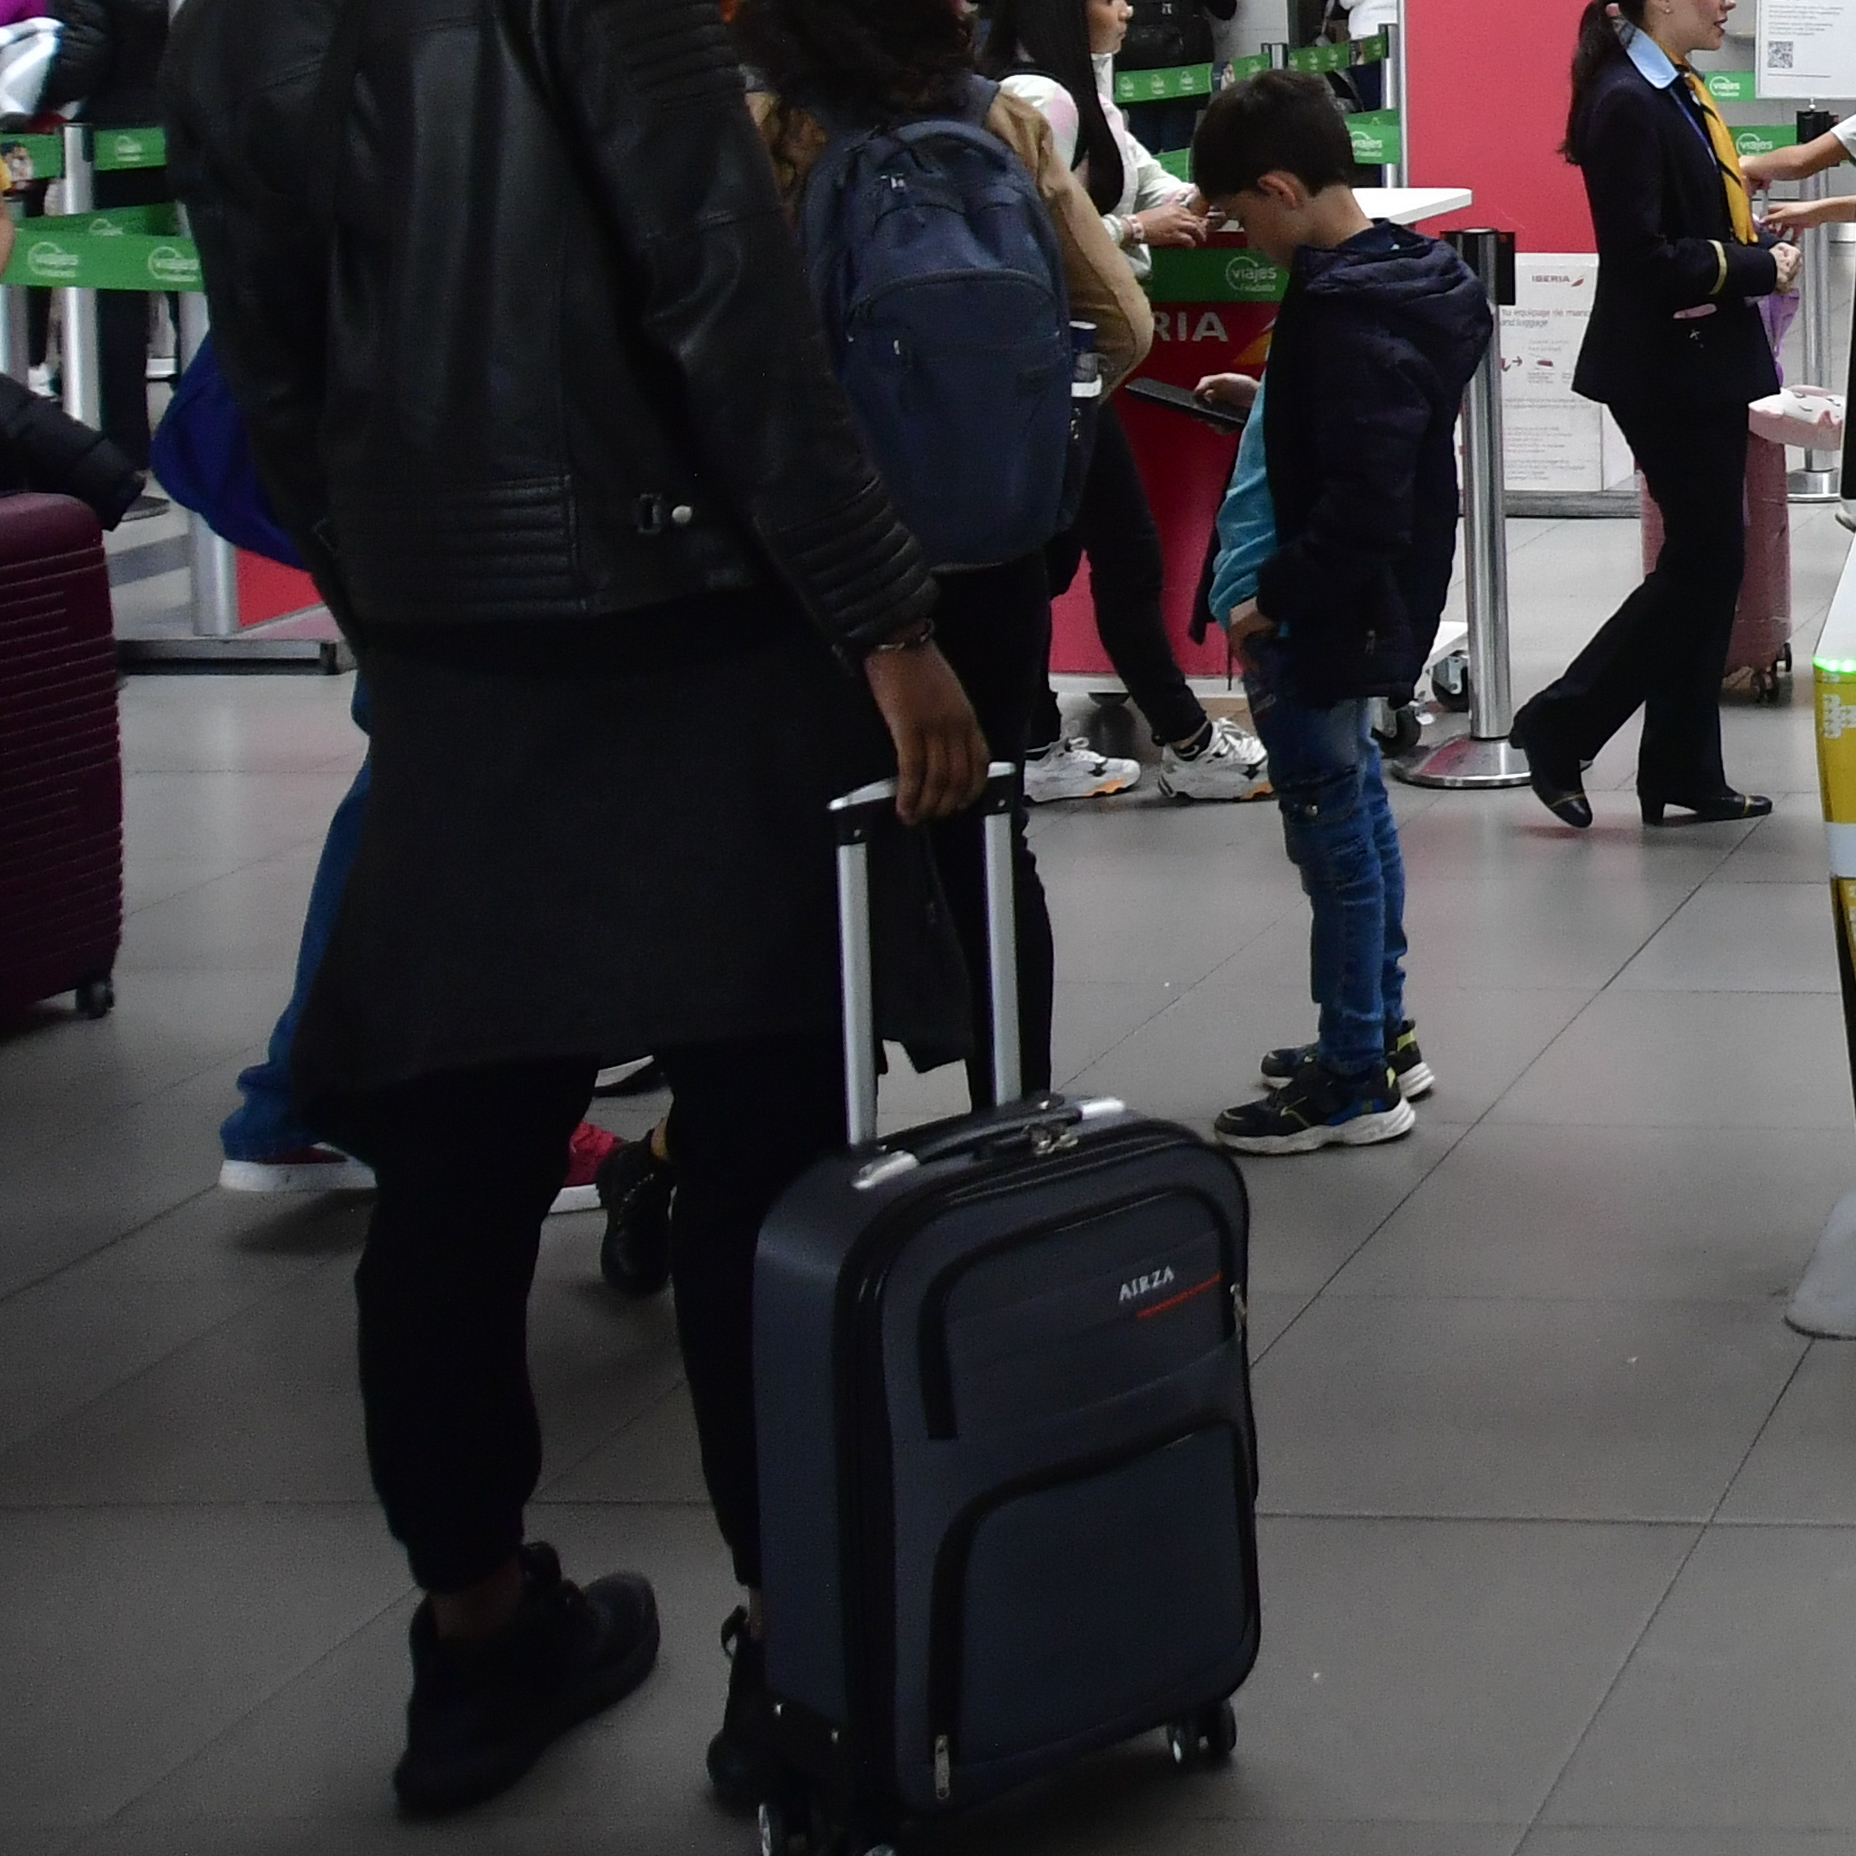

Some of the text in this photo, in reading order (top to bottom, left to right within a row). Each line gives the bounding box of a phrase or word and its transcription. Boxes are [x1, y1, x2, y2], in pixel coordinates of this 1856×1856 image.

[1232, 267, 1277, 283] viajes
[1532, 275, 1570, 283] IBERIA
[1153, 311, 1229, 342] RIA
[1516, 319, 1548, 329] luggage
[1119, 1265, 1175, 1301] AIRZA
